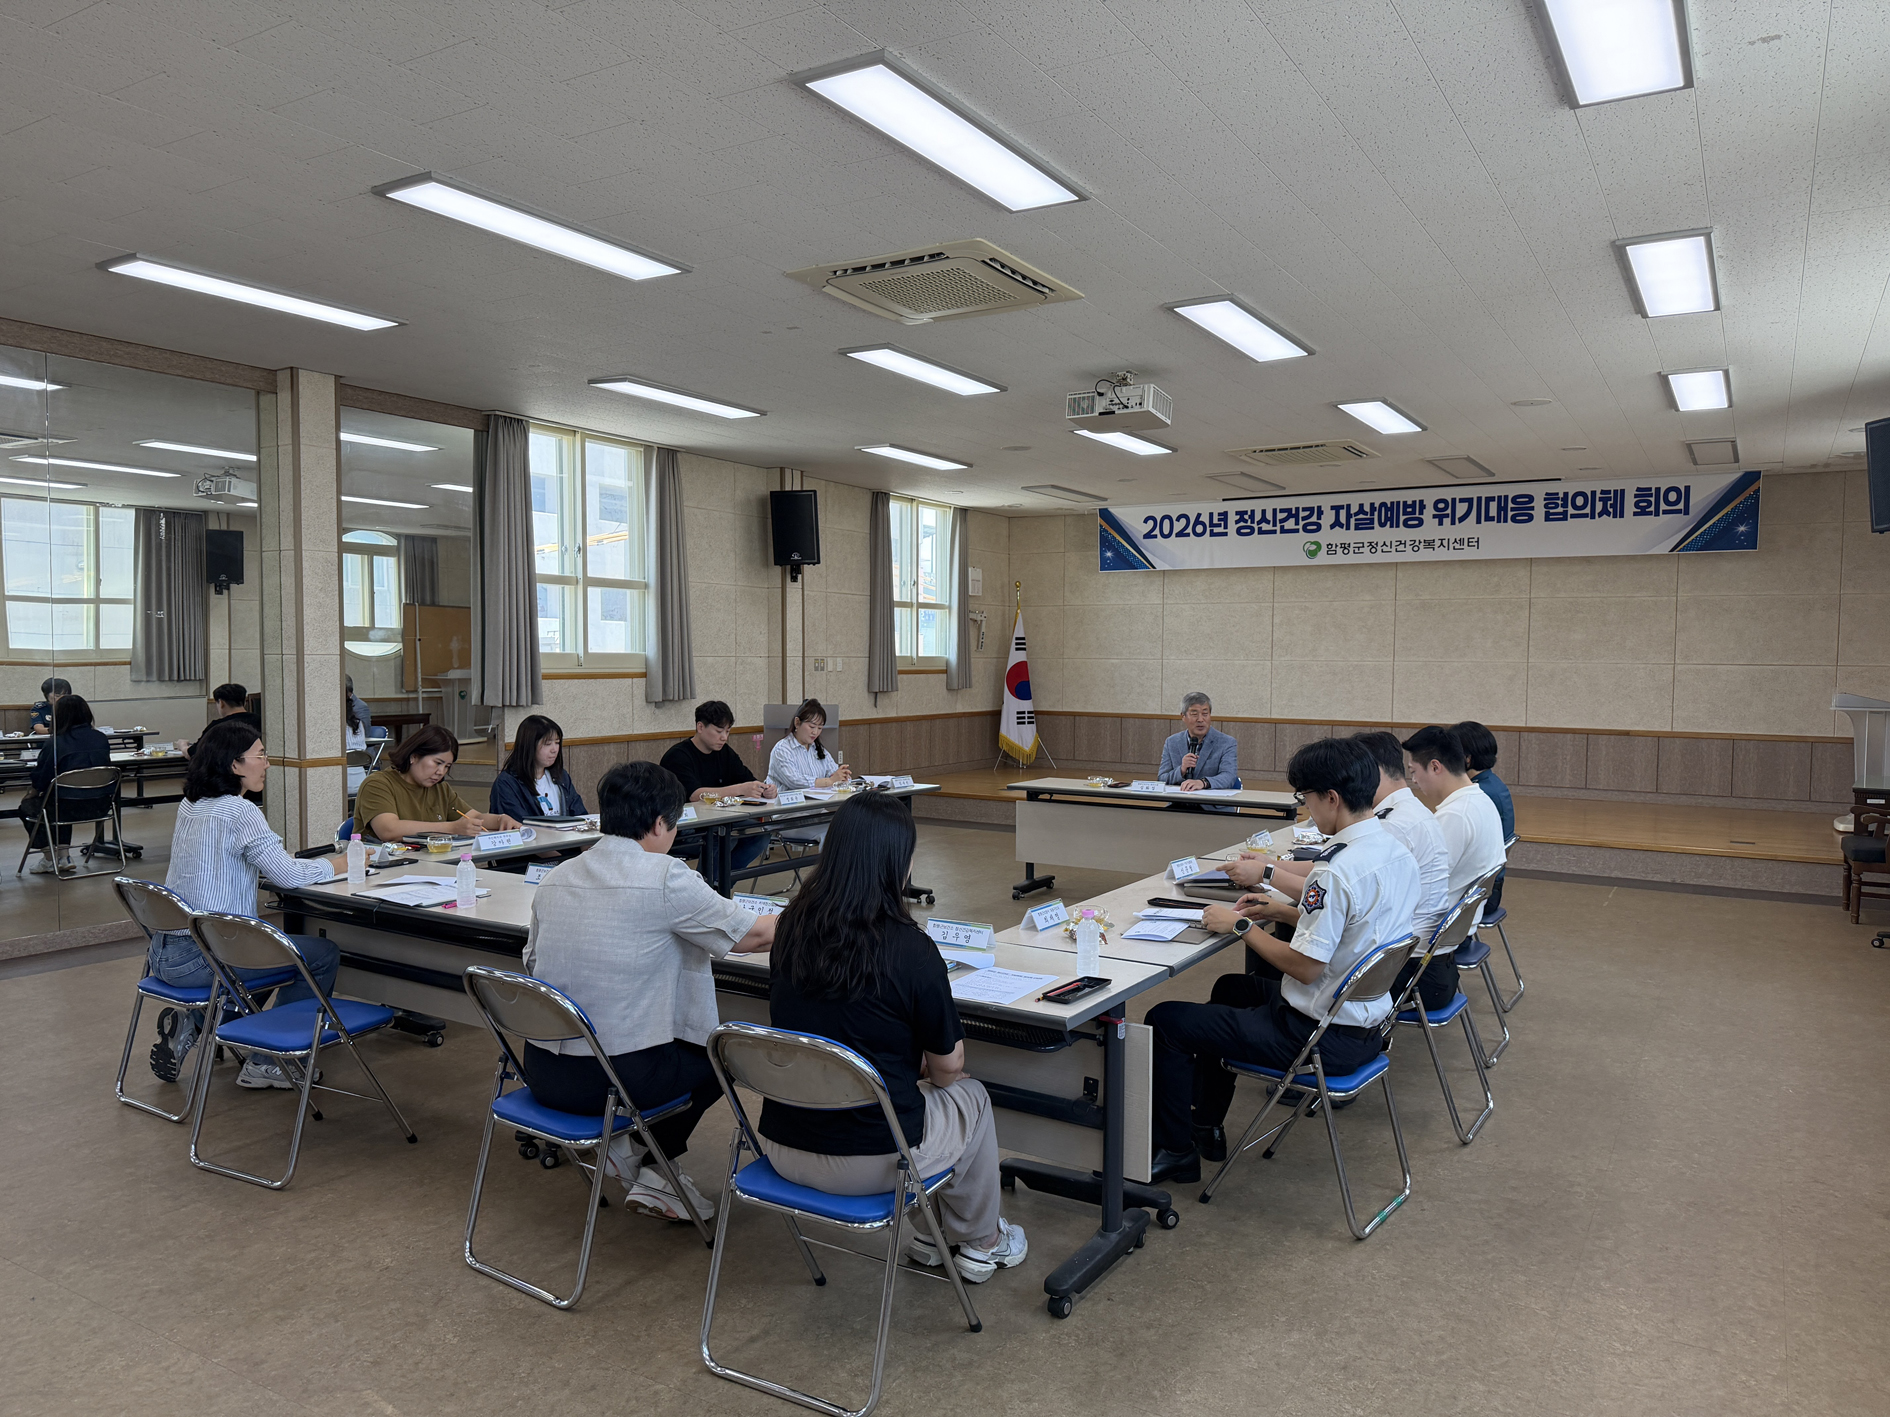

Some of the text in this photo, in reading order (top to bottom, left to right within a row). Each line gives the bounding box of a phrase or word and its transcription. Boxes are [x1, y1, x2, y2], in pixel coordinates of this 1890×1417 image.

[1142, 484, 1691, 540] 2026년 정신건강 자살예방 위기대응 협의체 회의
[1325, 536, 1481, 556] 함평군정신건강복지센터
